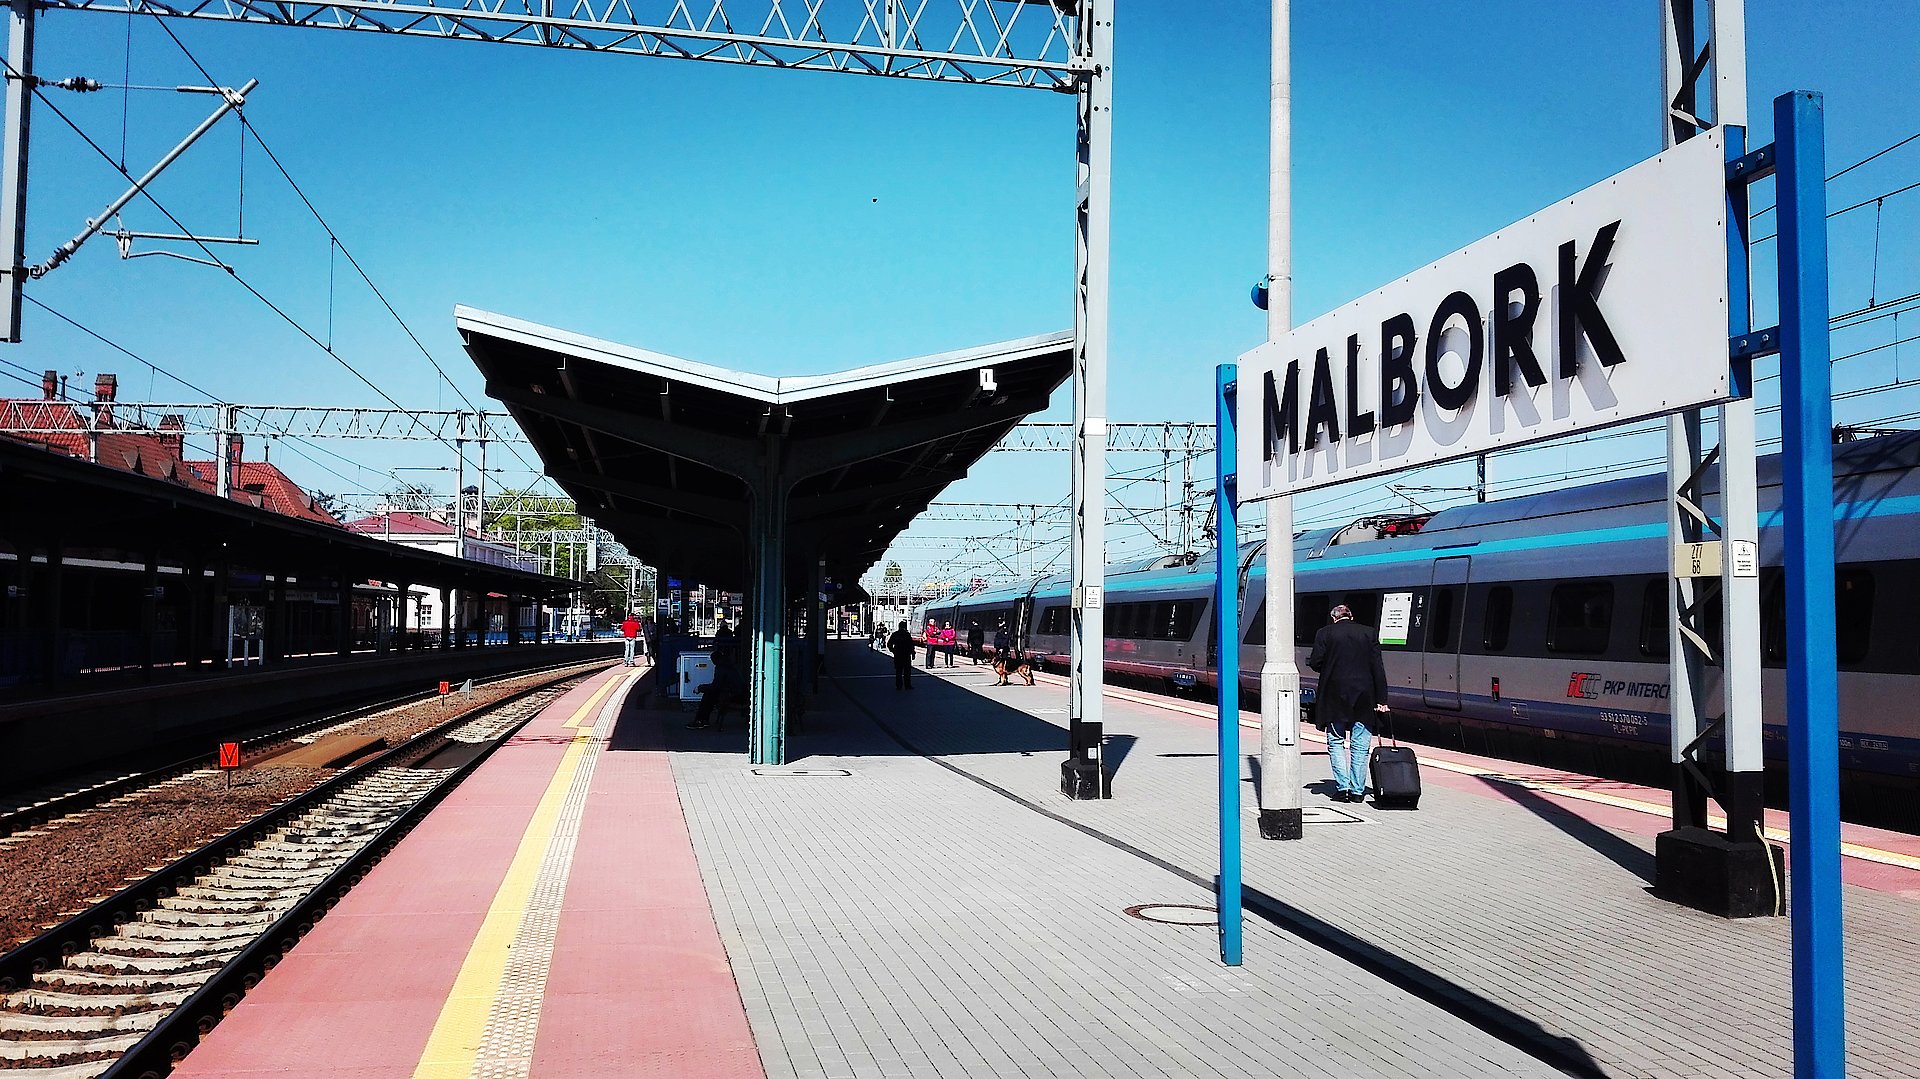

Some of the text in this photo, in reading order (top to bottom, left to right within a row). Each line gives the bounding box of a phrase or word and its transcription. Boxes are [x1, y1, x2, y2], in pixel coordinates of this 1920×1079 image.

[1262, 219, 1627, 462] MALBORK
[1691, 544, 1703, 559] 277
[1692, 560, 1701, 574] 68
[1603, 681, 1671, 700] PKP INTERCI
